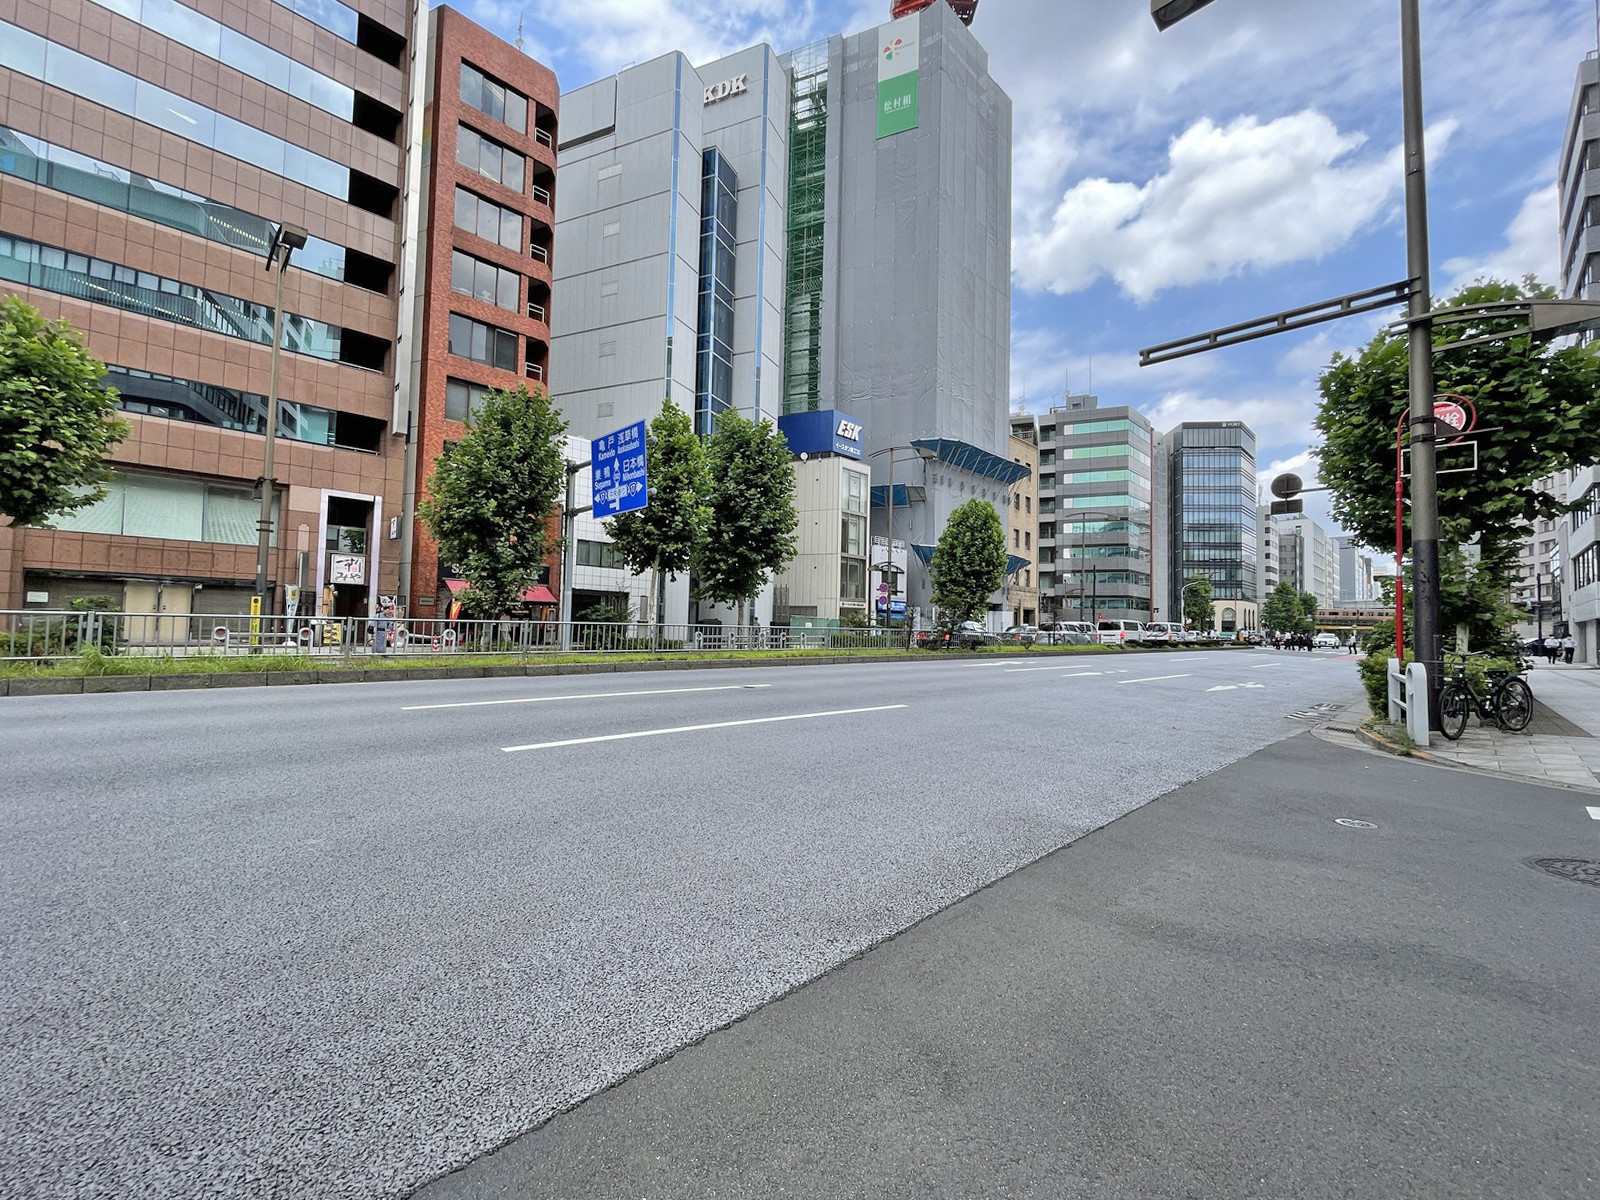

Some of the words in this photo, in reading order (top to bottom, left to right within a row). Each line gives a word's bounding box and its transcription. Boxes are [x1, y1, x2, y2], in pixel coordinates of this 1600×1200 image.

[704, 74, 747, 103] KDK
[617, 426, 639, 445] 浅草橋
[837, 420, 862, 441] ESK
[622, 454, 644, 473] 日本橋
